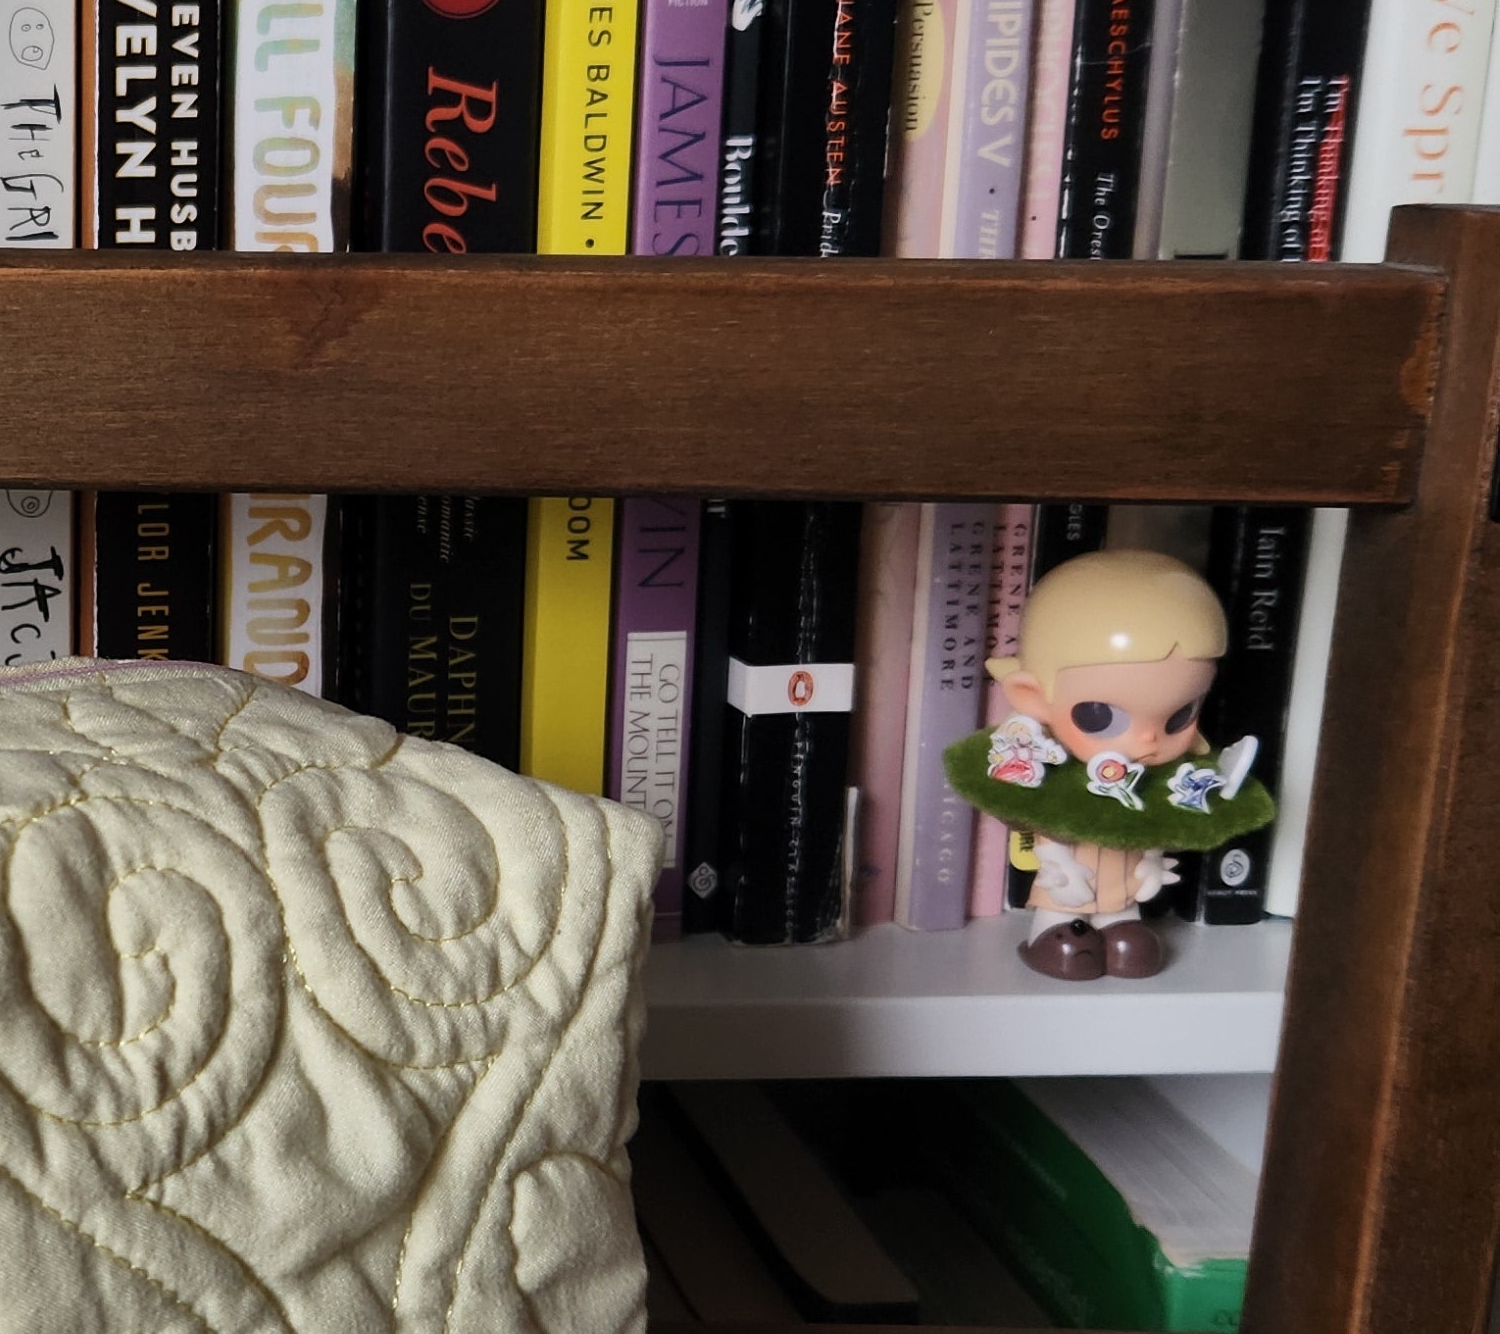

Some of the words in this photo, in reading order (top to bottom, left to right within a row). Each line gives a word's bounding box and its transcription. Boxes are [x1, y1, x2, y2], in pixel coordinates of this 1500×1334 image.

[903, 0, 934, 133] Persuasion
[423, 66, 499, 255] Rebe
[580, 63, 613, 222] BALDWIN
[653, 53, 712, 257] JAMES
[825, 80, 852, 186] AUSTEN
[976, 135, 1017, 169] V
[1402, 83, 1464, 193] Spr
[0, 173, 65, 242] GRI
[169, 140, 200, 253] HUSB
[719, 135, 755, 256] Boulde
[1093, 172, 1116, 207] The
[114, 206, 157, 245] H
[818, 209, 843, 258] Prid
[1088, 211, 1113, 260] Ores
[136, 502, 171, 562] LOR
[415, 495, 429, 537] ense
[439, 495, 454, 564] omantic
[462, 496, 478, 544] lassic
[565, 497, 592, 562] OOM
[1066, 503, 1084, 542] GLES
[966, 521, 985, 617] GRENE
[1008, 523, 1027, 616] GRENE
[1256, 524, 1289, 580] Iain
[136, 582, 171, 661] JENK
[241, 494, 315, 686] RAND
[408, 582, 433, 622] DU
[940, 522, 965, 691] LATTIMORE
[983, 523, 1008, 687] LATTIMOE
[1247, 588, 1278, 653] Reid
[406, 634, 439, 739] MAUR
[446, 614, 479, 743] DAPHN
[629, 653, 654, 701] THE
[656, 663, 680, 704] GO
[961, 636, 976, 689] AND
[625, 709, 651, 809] MOUNT
[655, 710, 678, 764] TELL
[654, 770, 676, 793] IT
